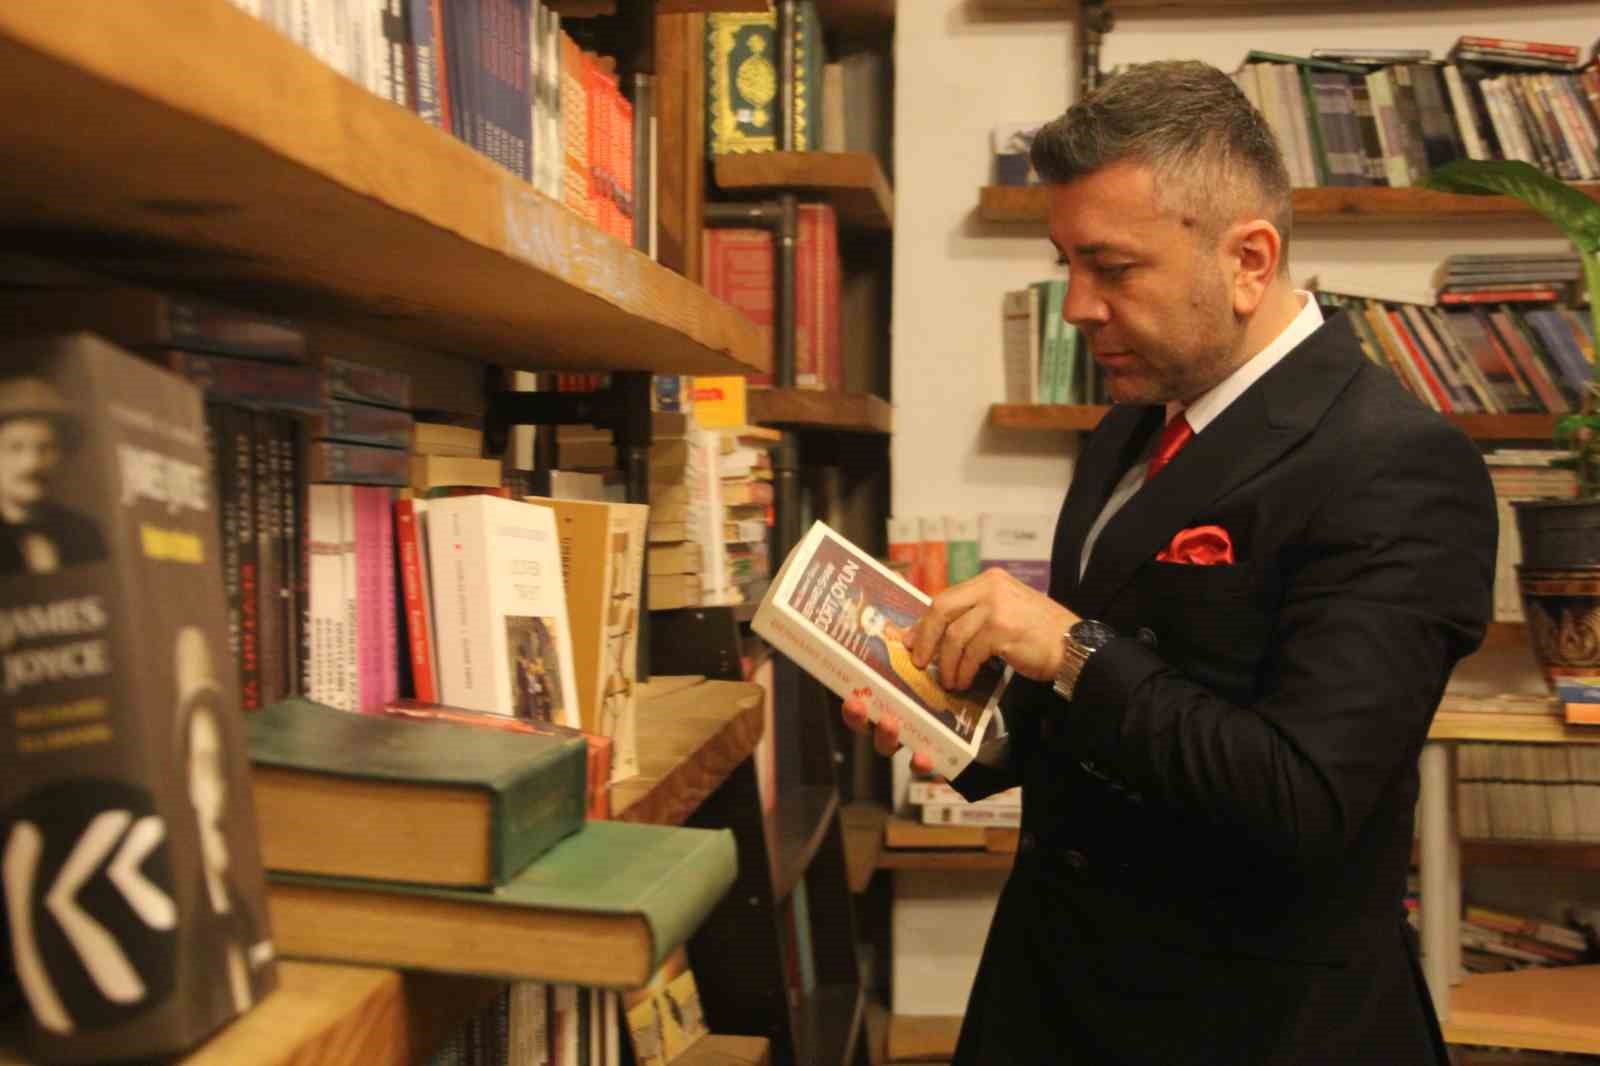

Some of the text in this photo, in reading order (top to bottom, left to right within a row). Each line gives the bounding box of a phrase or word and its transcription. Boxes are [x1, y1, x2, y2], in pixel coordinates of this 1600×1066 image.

[830, 559, 860, 600] OYUN
[0, 597, 106, 650] JAMES
[5, 640, 107, 692] JOYCE
